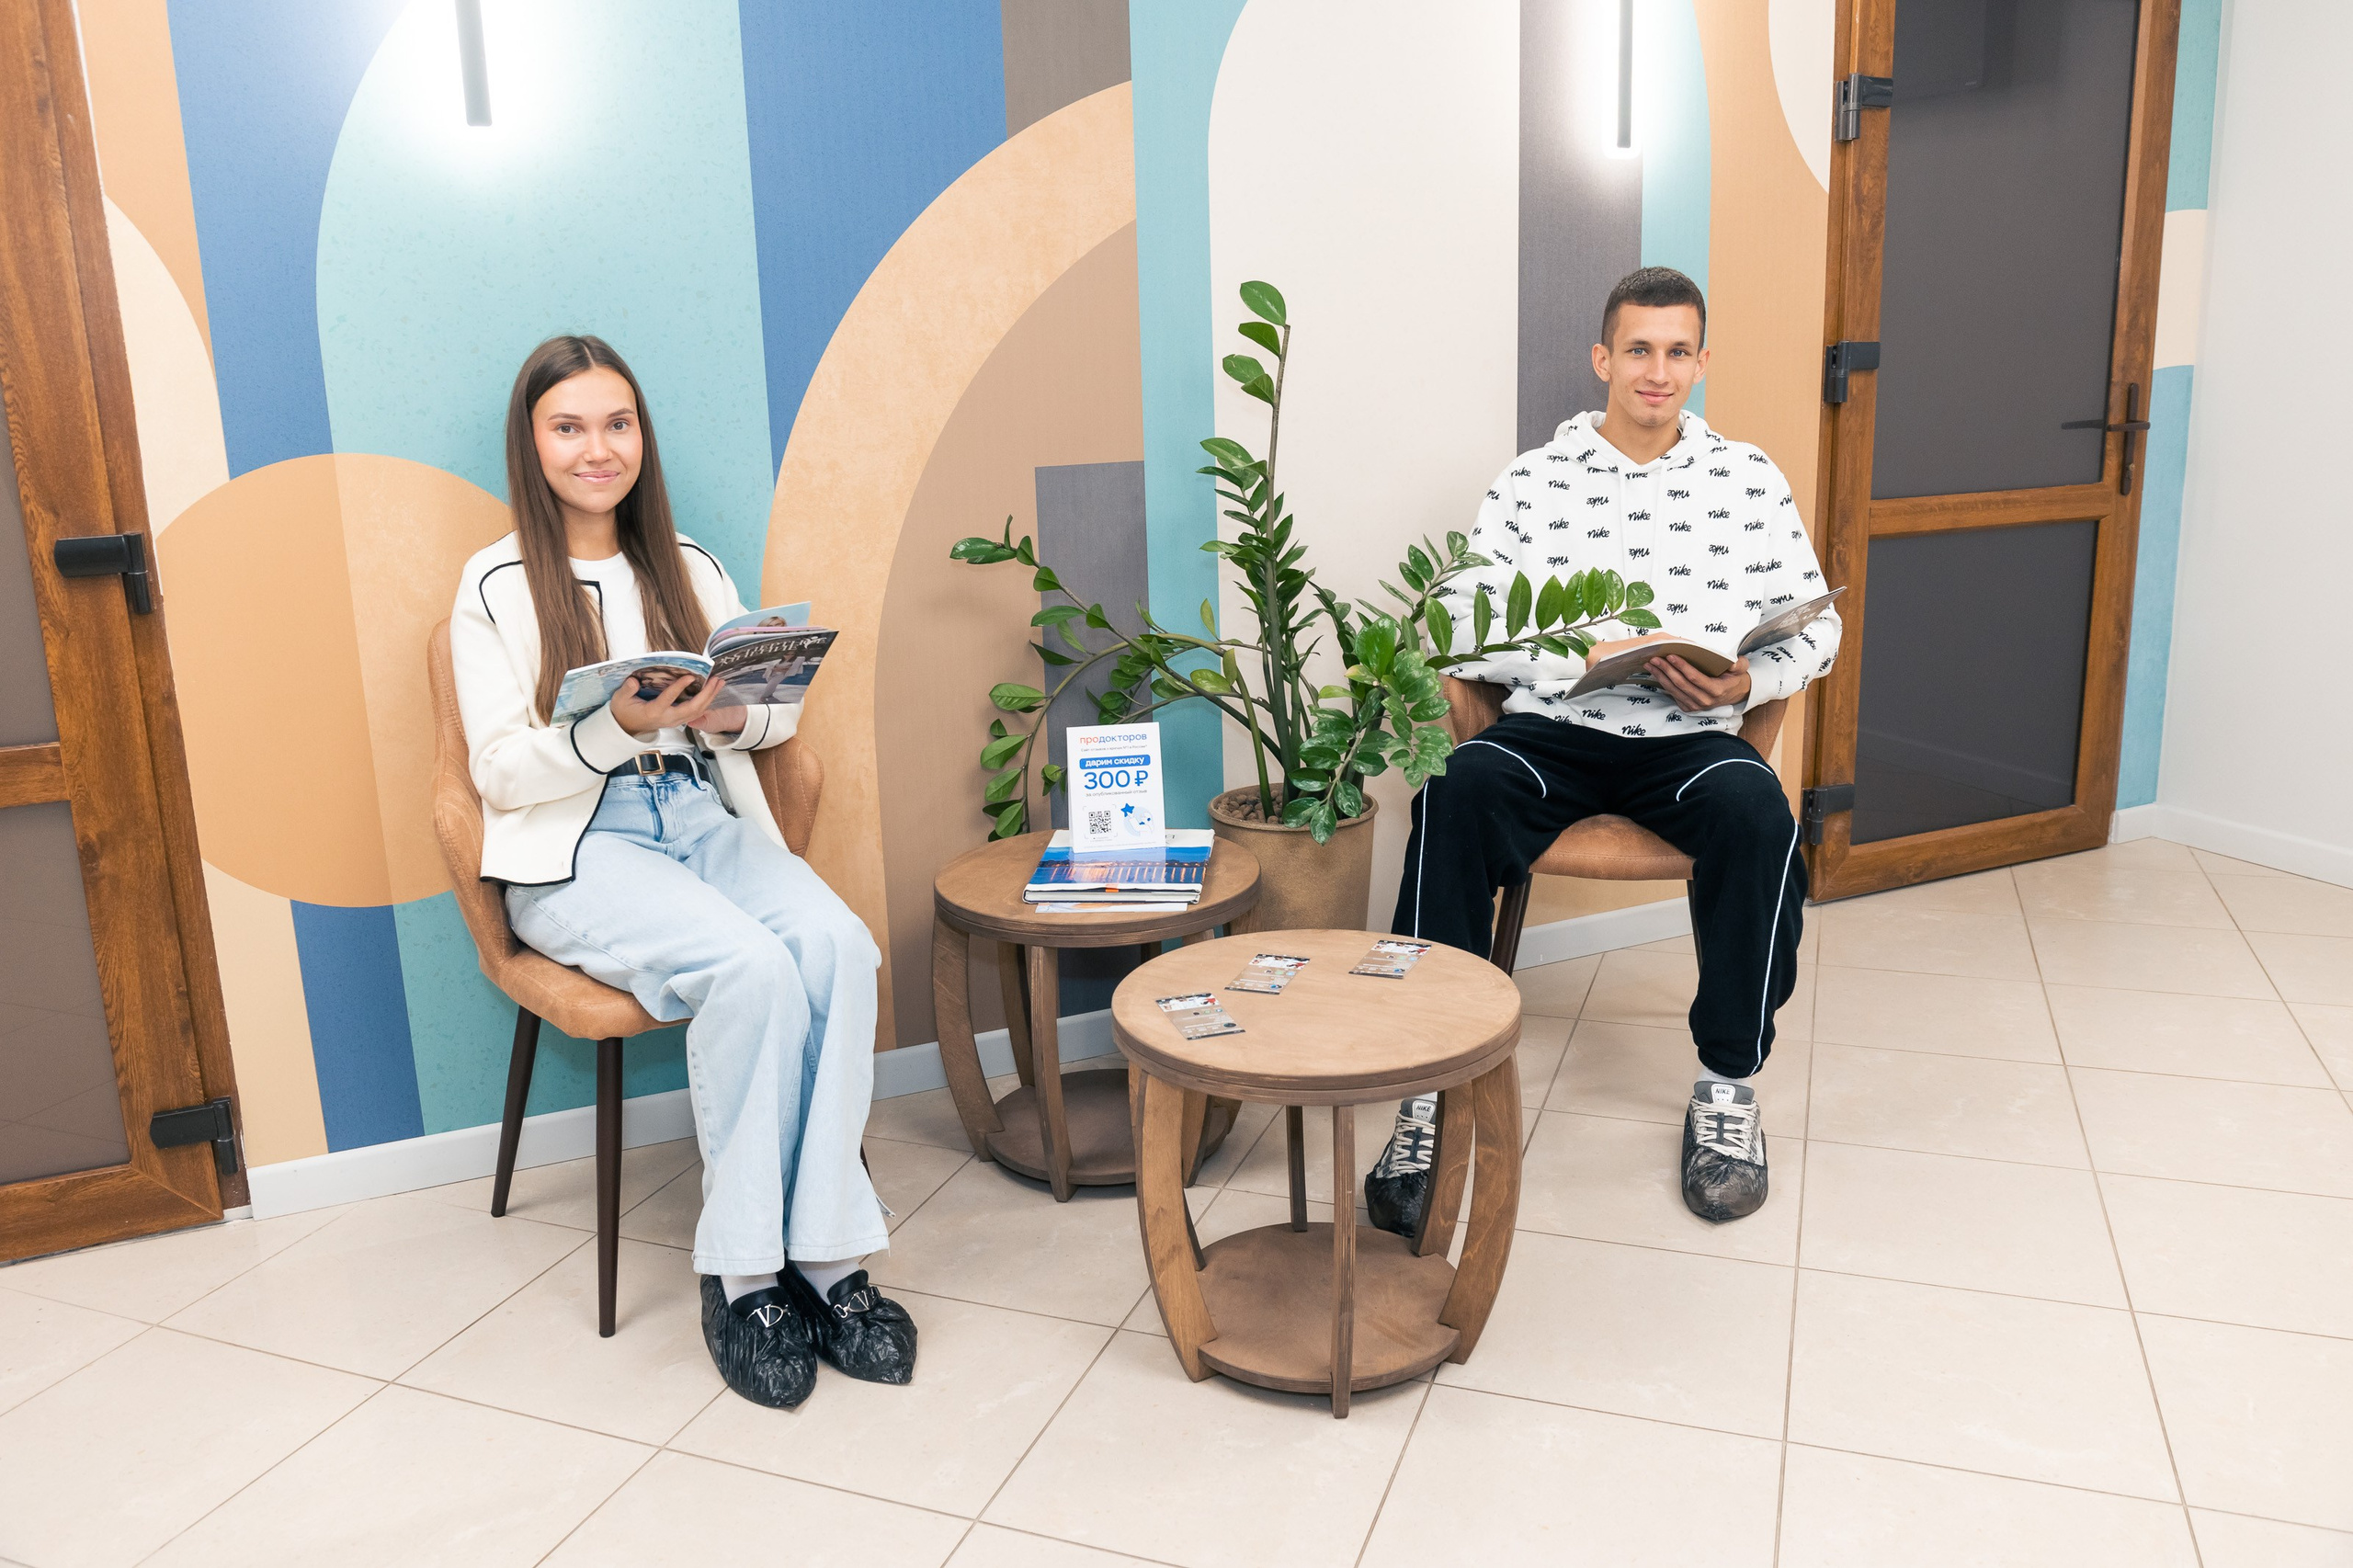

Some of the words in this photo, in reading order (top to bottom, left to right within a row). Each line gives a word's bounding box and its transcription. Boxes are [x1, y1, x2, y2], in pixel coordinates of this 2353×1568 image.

[1510, 466, 1531, 478] nike
[1709, 466, 1731, 478] nike
[1548, 480, 1571, 491] nike
[1667, 489, 1690, 501] nike
[1745, 487, 1767, 500] nike
[1586, 495, 1609, 508] nike
[1628, 508, 1651, 521] nike
[1708, 507, 1731, 519] nike
[1549, 517, 1570, 530] nike
[1669, 520, 1692, 532] nike
[1744, 518, 1765, 532] nike
[1519, 531, 1533, 544] ike
[1587, 526, 1610, 539] nike
[1629, 548, 1651, 560] nike
[1708, 544, 1730, 557] nike
[1547, 555, 1569, 568] nike
[1668, 563, 1691, 576] nike
[1707, 578, 1730, 591] nike
[1769, 593, 1794, 606] nike
[1666, 603, 1688, 616] nike
[1704, 621, 1728, 633] nike
[1582, 709, 1606, 721] nike
[1621, 723, 1647, 737] nike
[1079, 733, 1147, 745] продокторов
[1086, 758, 1112, 767] дарим
[1114, 756, 1144, 766] скидку
[1084, 770, 1131, 790] 300
